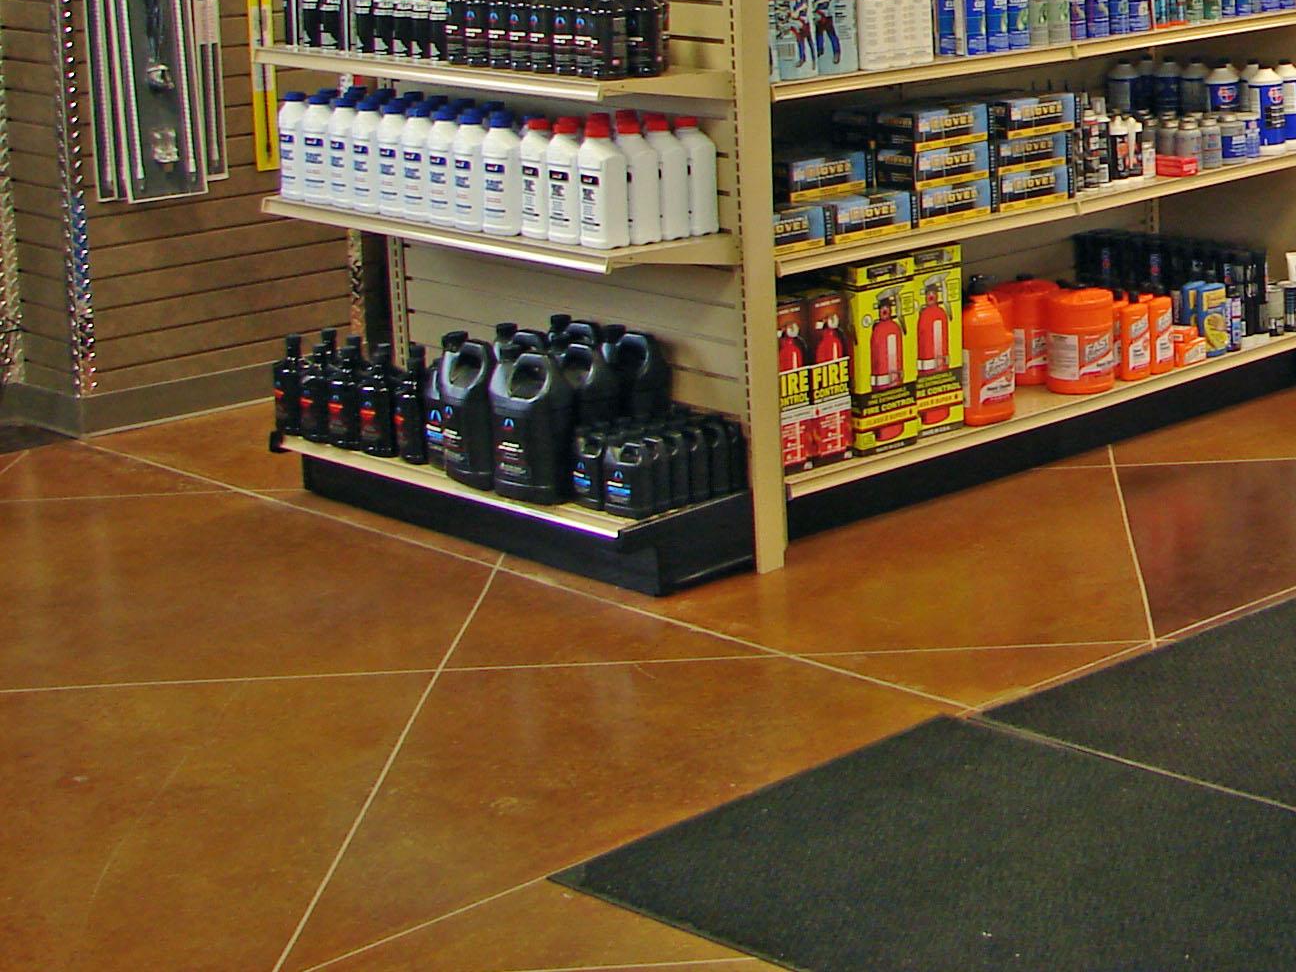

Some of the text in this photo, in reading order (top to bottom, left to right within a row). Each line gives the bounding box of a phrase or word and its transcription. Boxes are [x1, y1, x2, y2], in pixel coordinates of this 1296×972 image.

[781, 369, 809, 396] IRE
[813, 360, 849, 389] FIRE
[814, 382, 848, 399] CONTROL
[927, 382, 961, 395] CONTROL
[881, 397, 915, 412] CONTROL
